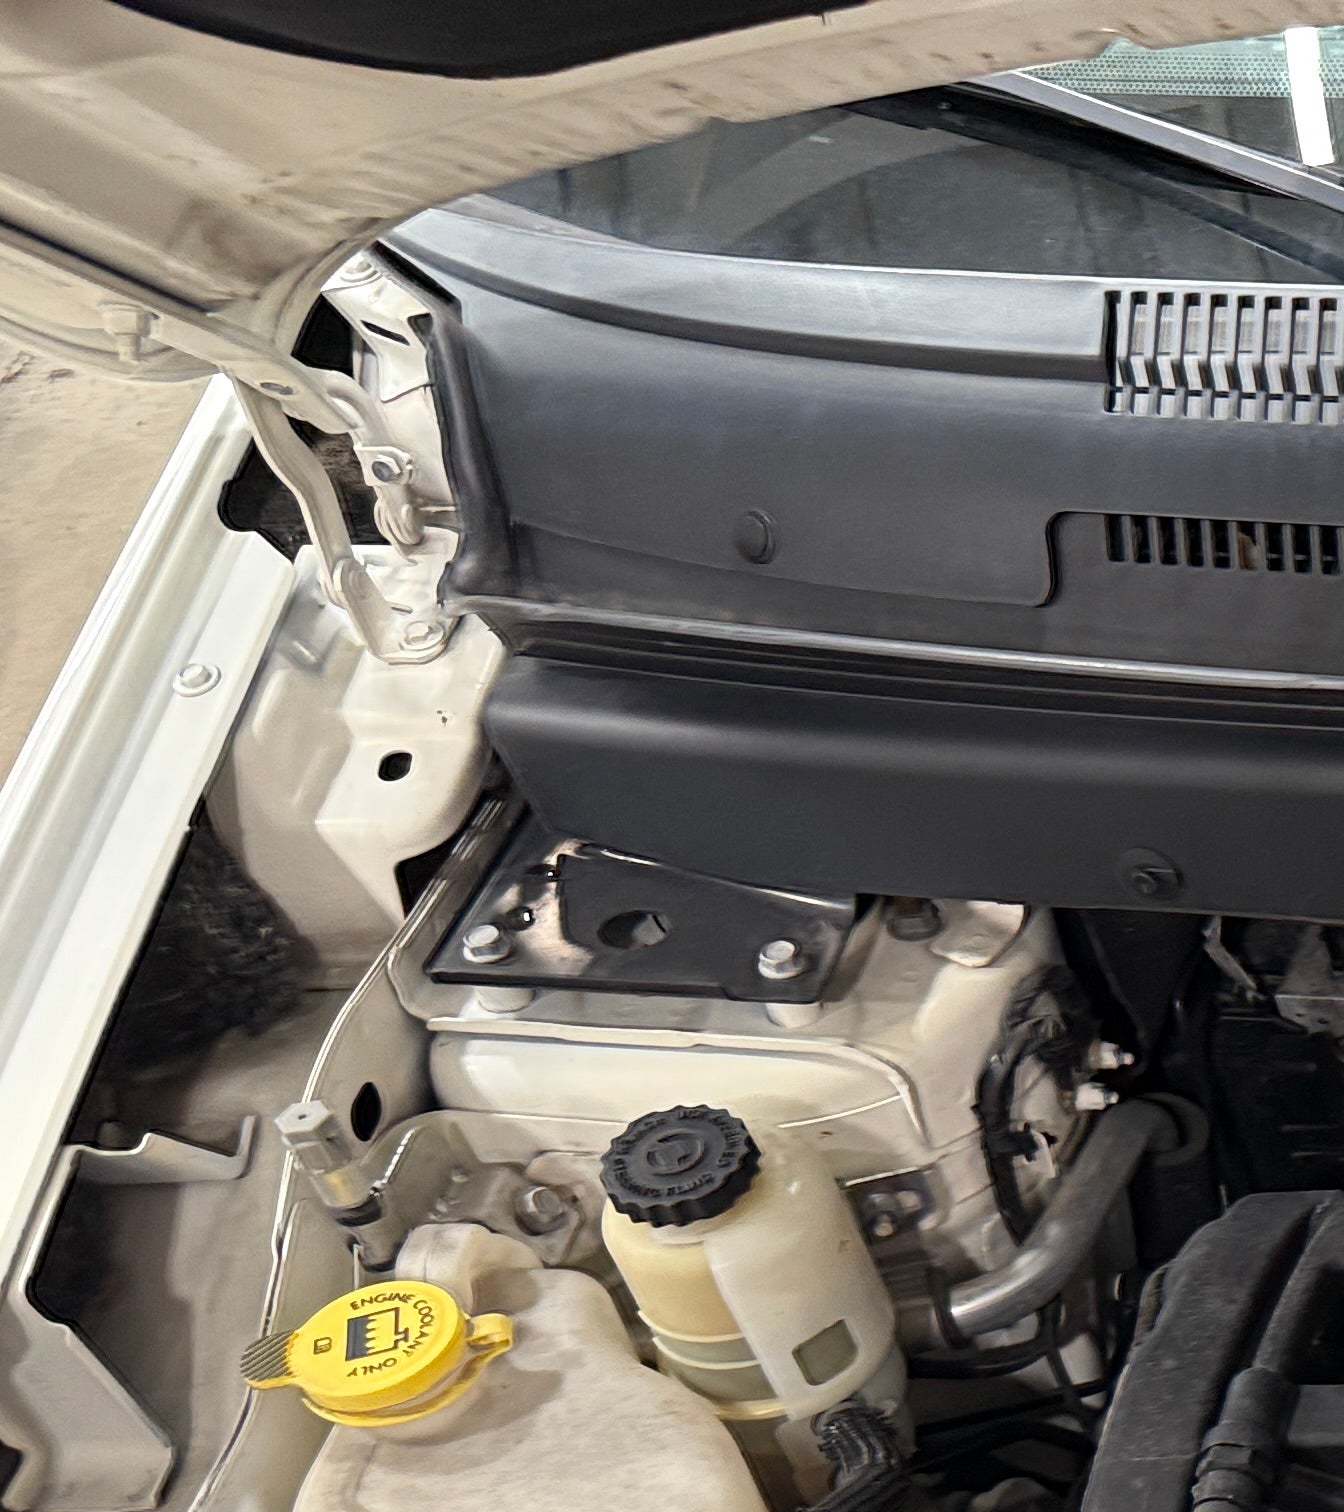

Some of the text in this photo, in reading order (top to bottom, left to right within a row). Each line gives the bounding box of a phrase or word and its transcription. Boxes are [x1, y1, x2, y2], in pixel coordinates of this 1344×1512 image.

[346, 1292, 435, 1377] ENGINE COOLANT ONLY
